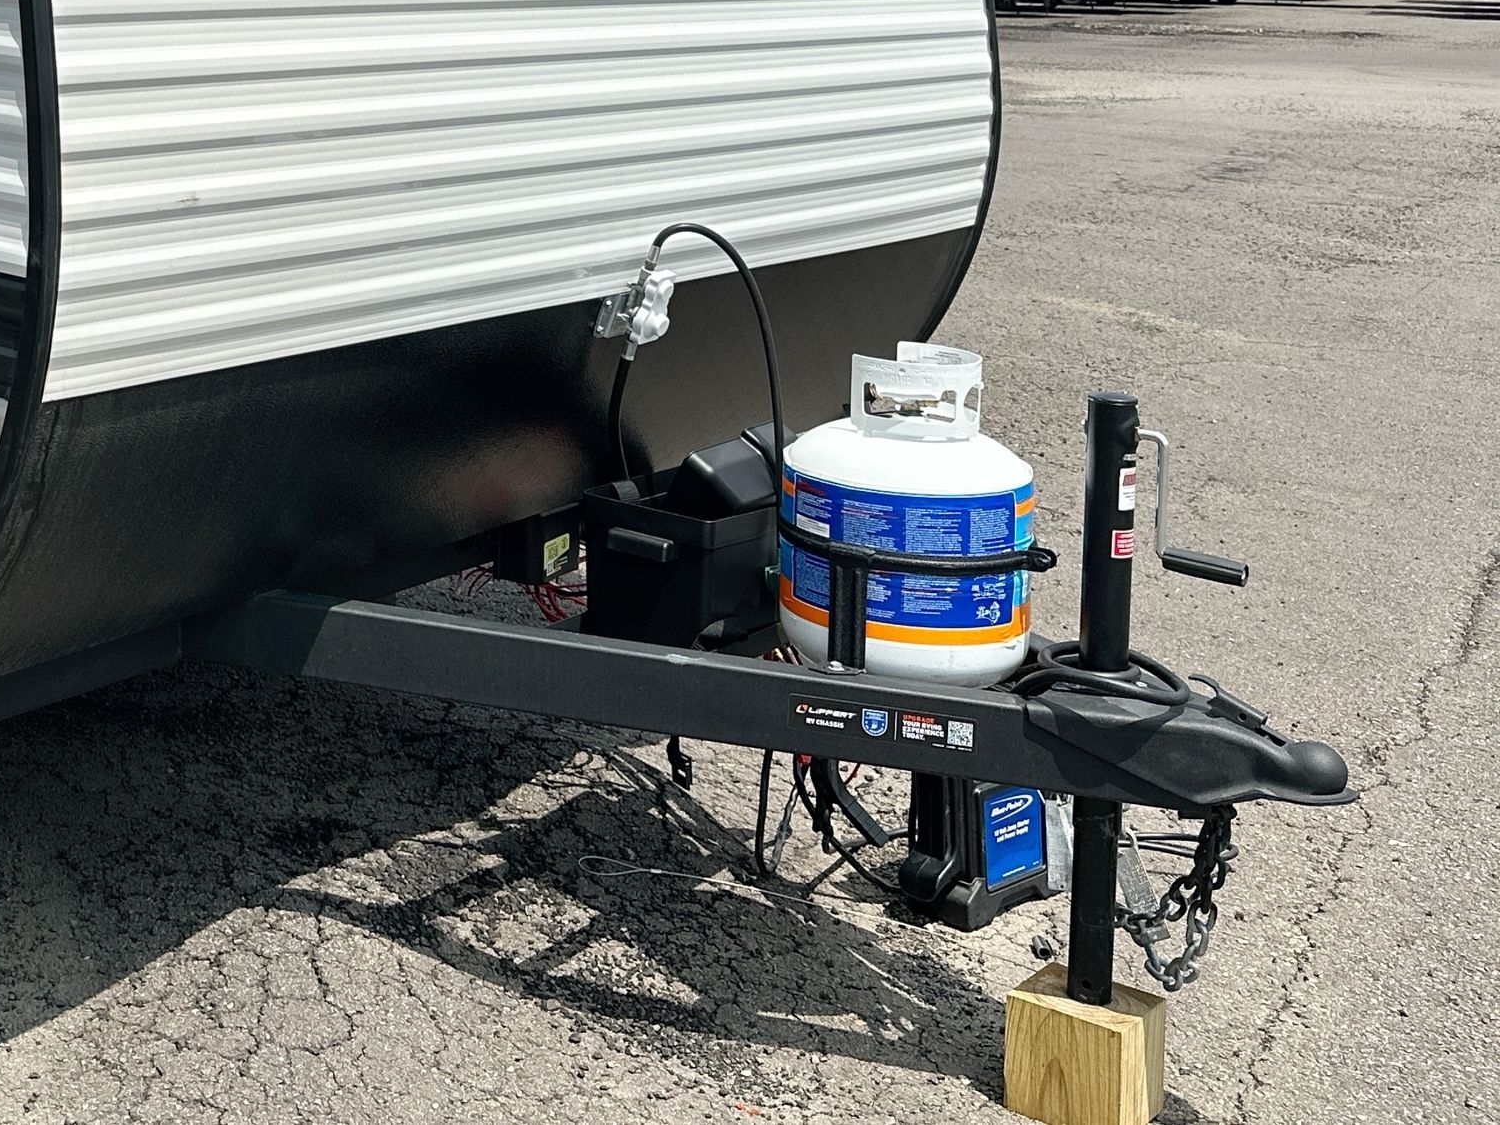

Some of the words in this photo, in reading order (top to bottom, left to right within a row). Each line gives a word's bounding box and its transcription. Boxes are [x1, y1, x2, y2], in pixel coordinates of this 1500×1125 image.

[902, 714, 935, 723] UPGRADE
[816, 719, 844, 728] CHASSIS
[922, 722, 942, 730] RVING
[902, 726, 944, 737] EXPERIENCE
[902, 732, 925, 740] TODAY.
[1017, 819, 1030, 828] Starter
[1004, 831, 1016, 840] Power
[1016, 826, 1028, 835] Supply
